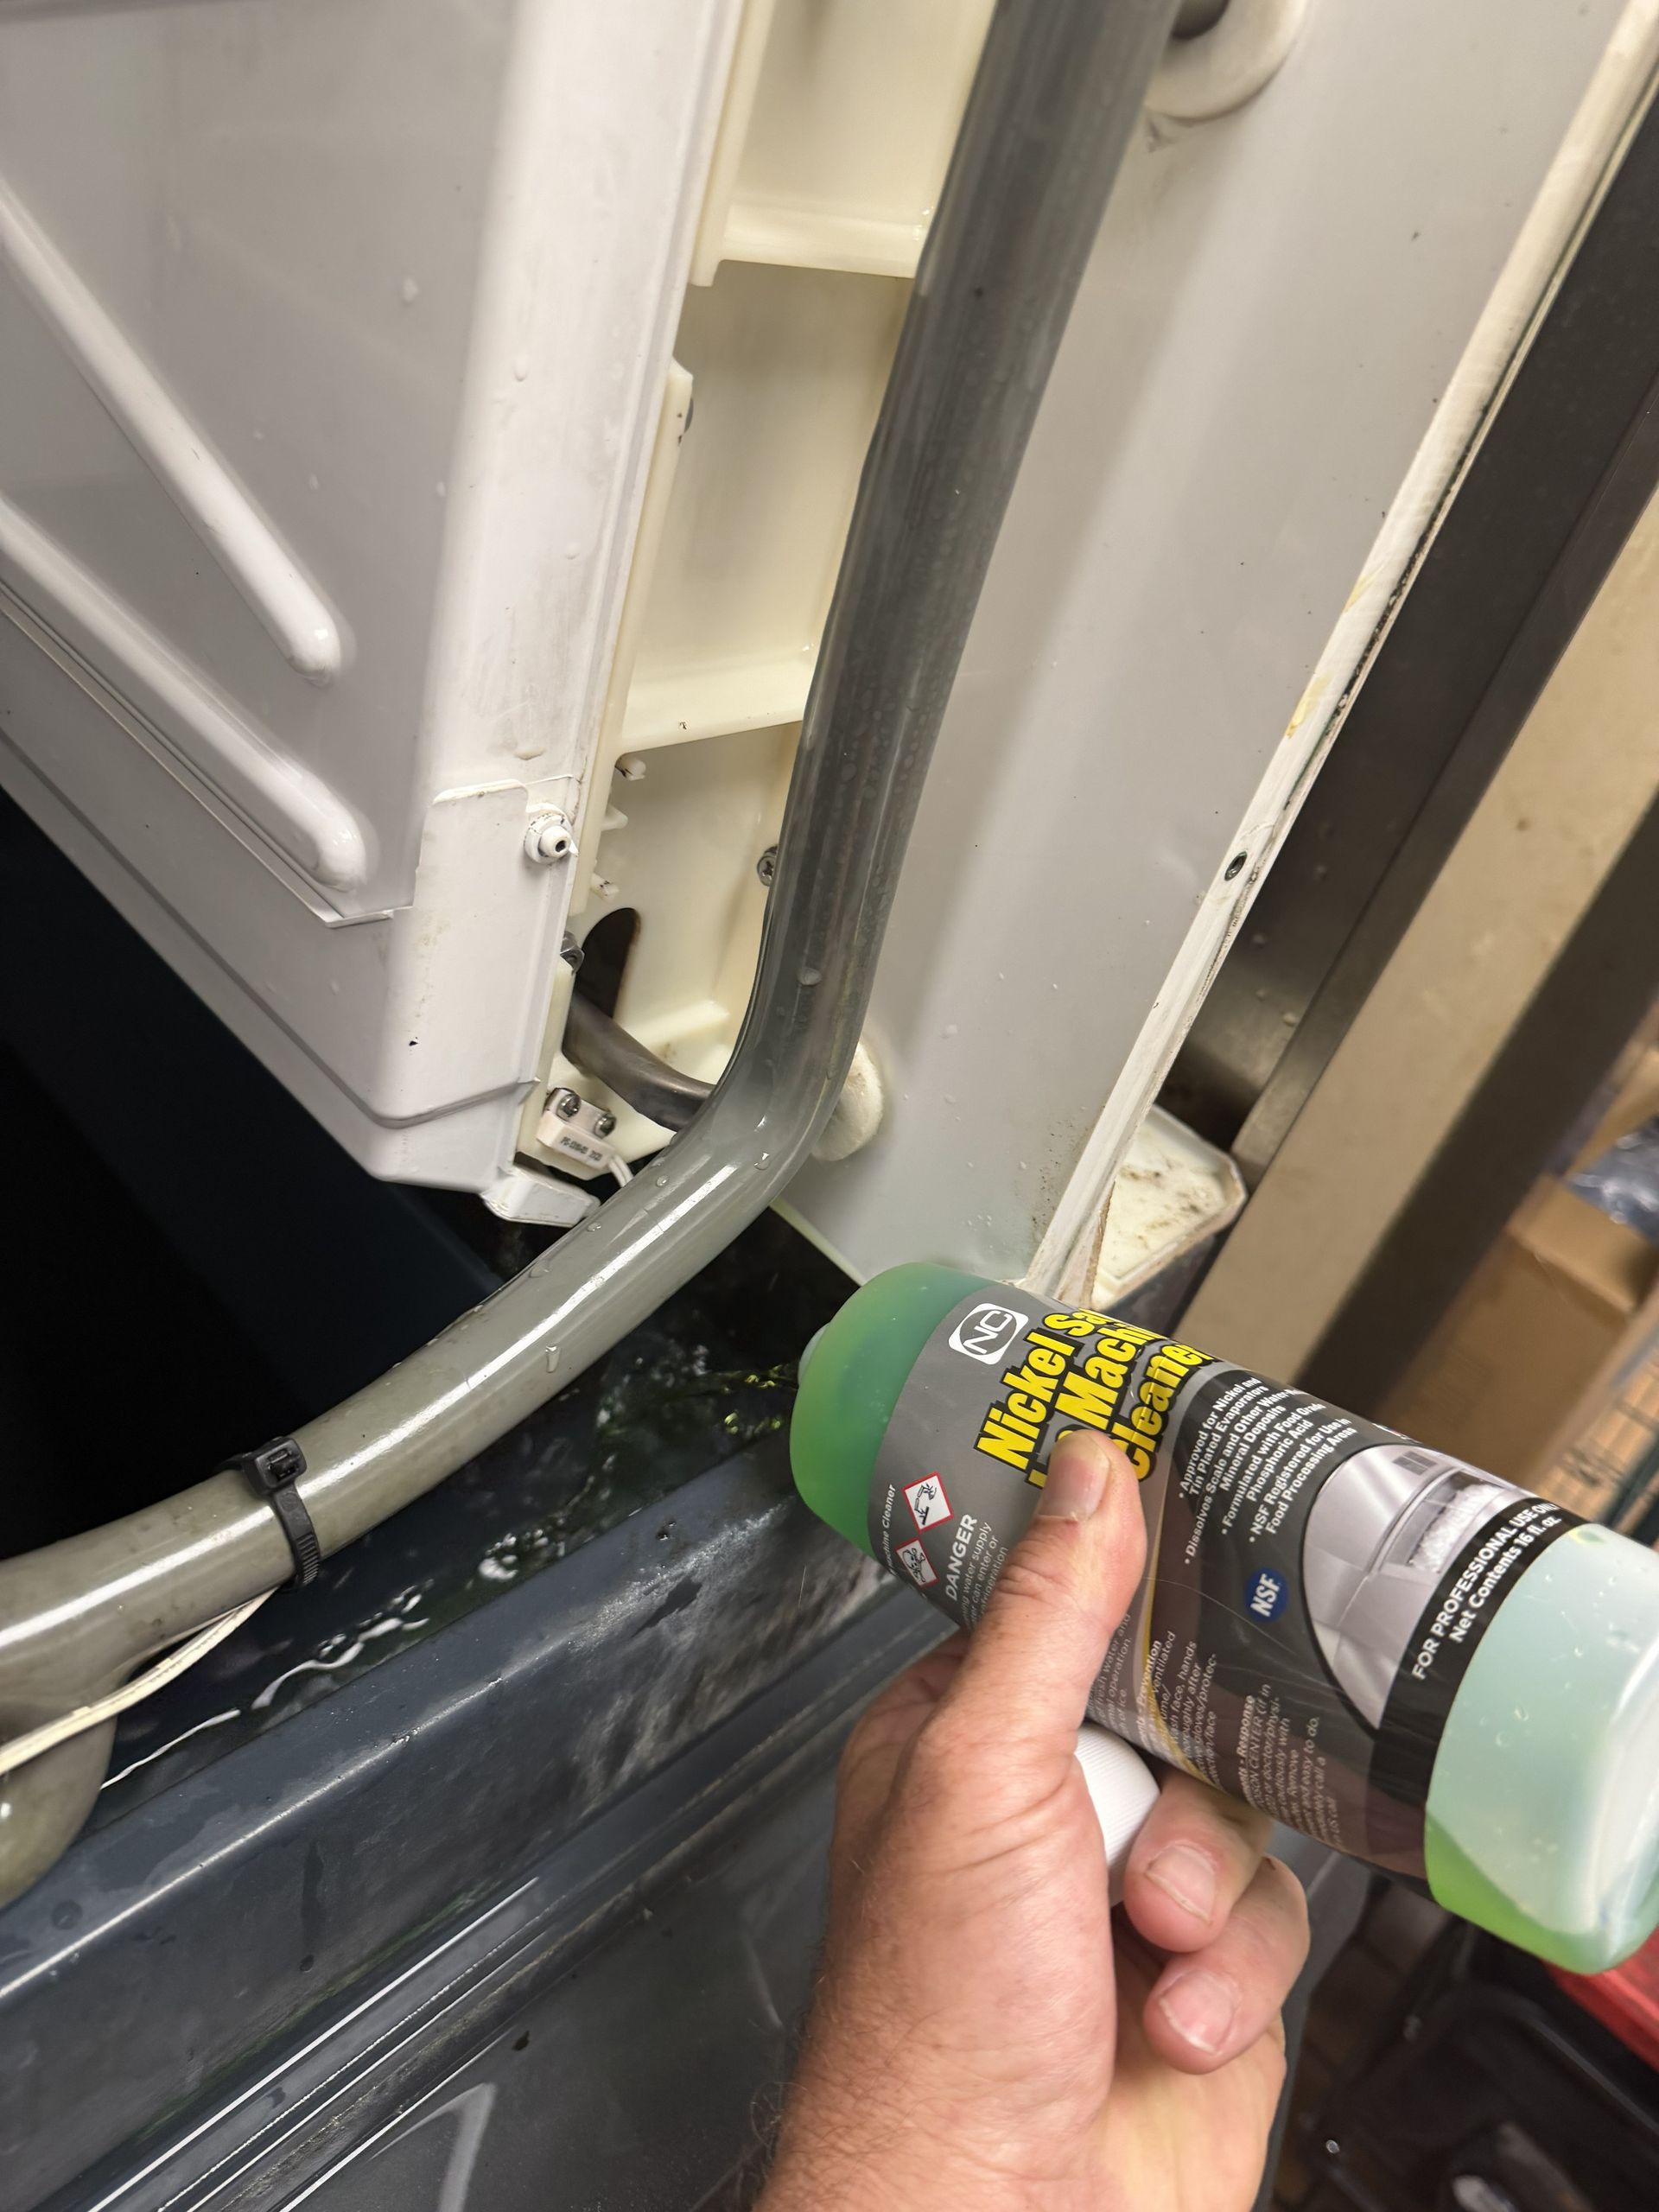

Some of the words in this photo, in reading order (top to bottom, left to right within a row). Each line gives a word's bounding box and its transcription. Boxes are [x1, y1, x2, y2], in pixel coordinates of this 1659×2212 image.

[963, 1309, 1012, 1354] NC
[973, 1328, 1077, 1471] Nickel
[1041, 1309, 1111, 1338] Sa
[1179, 1429, 1208, 1492] Approved
[1201, 1410, 1219, 1430] for
[1212, 1382, 1243, 1412] Nickel
[1240, 1375, 1261, 1388] and
[1188, 1472, 1205, 1497] Tin
[1197, 1432, 1221, 1474] Plated
[1215, 1382, 1268, 1432] Evaporators
[1219, 1442, 1250, 1491] Mineral
[1244, 1403, 1286, 1443] Deposits
[1246, 1437, 1294, 1503] Phosphoric
[1289, 1418, 1313, 1439] Acid
[1185, 1494, 1213, 1557] Dissolves
[1205, 1457, 1228, 1493] Scale
[1221, 1432, 1240, 1458] and
[1233, 1403, 1262, 1433] Other
[1223, 1454, 1262, 1528] Formulated
[1256, 1429, 1281, 1456] with
[1275, 1410, 1301, 1433] Food
[1249, 1503, 1272, 1535] NSF
[1263, 1443, 1311, 1505] Registered
[1304, 1429, 1325, 1446] for
[1318, 1419, 1342, 1435] Use
[1265, 1500, 1289, 1535] Food
[1281, 1440, 1334, 1502] Processing
[1325, 1424, 1357, 1446] Areas
[881, 1484, 896, 1528] Cleaner
[943, 1513, 978, 1601] DANGER
[961, 1560, 976, 1592] water
[969, 1521, 994, 1561] supply
[978, 1549, 992, 1580] enter
[987, 1534, 1000, 1549] or
[1448, 1608, 1477, 1644] Net
[1467, 1544, 1522, 1610] Contents
[1513, 1530, 1535, 1549] 16
[1249, 1573, 1281, 1618] NSF
[1411, 1635, 1440, 1681] FOR
[1430, 1522, 1517, 1637] PROFESSIONAL
[1509, 1506, 1539, 1527] USE
[1109, 1635, 1132, 1697] operation.
[1135, 1639, 1161, 1706] Prevention
[1178, 1640, 1198, 1680] hands
[1186, 1662, 1202, 1694] after
[1236, 1694, 1255, 1757] Response
[1250, 1715, 1263, 1768] CENTER
[1279, 1716, 1290, 1745] with
[1304, 1738, 1315, 1753] to
[1306, 1714, 1319, 1737] do.
